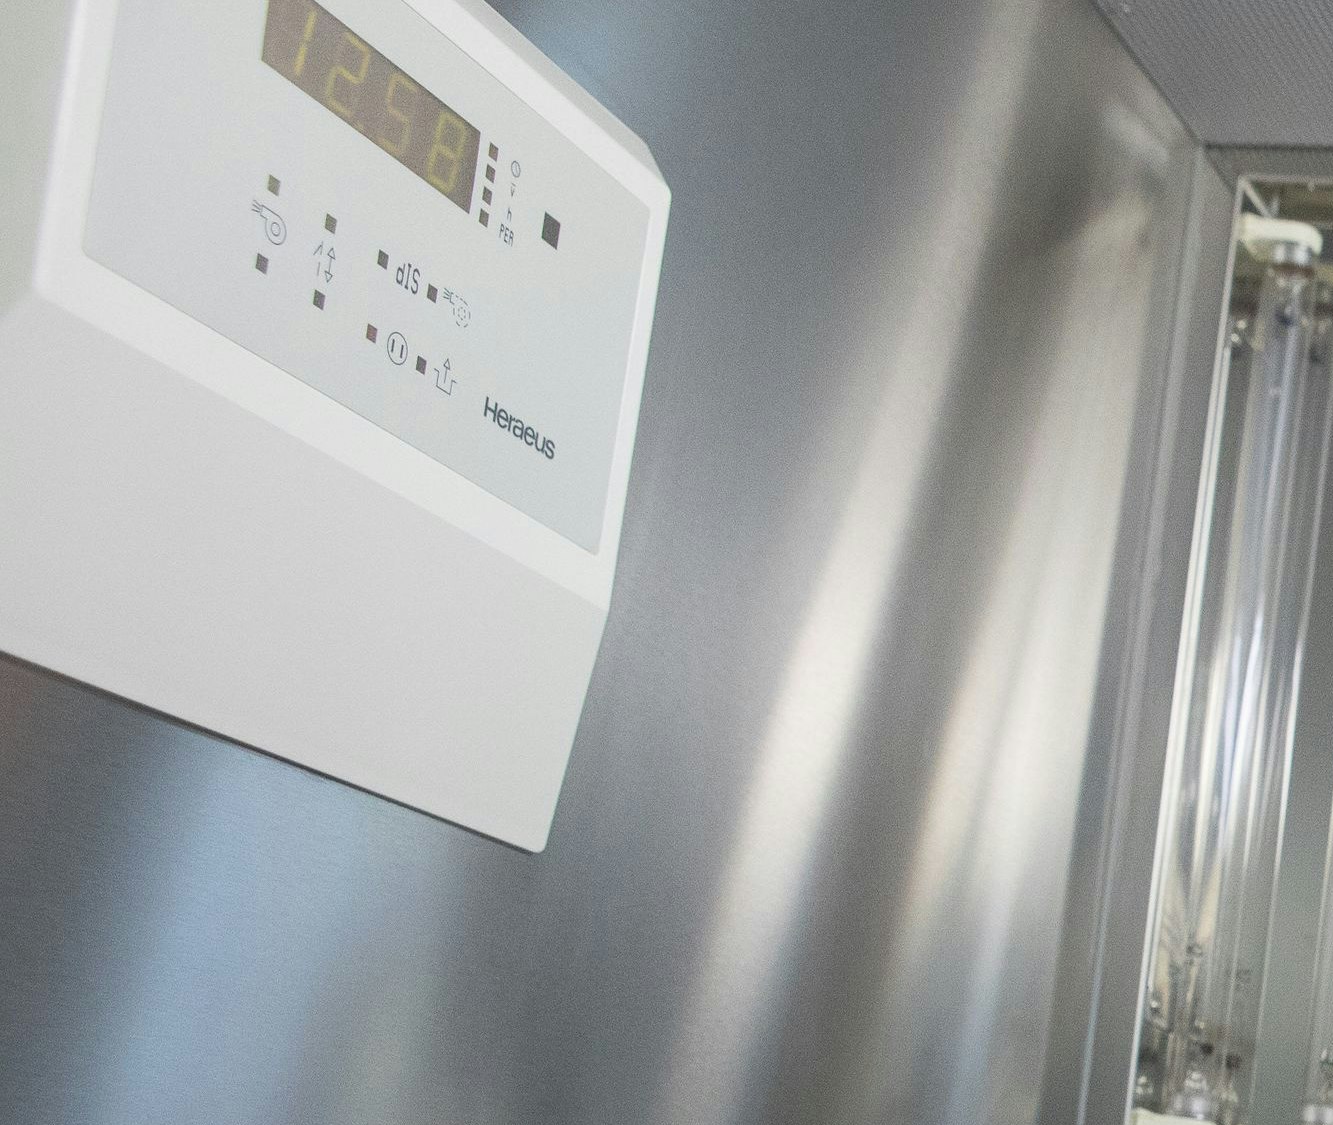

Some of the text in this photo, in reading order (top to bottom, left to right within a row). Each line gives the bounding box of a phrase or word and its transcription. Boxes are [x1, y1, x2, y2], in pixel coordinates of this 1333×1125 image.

[294, 10, 468, 194] 1258
[498, 222, 515, 248] PER
[483, 395, 556, 460] Heraeus
